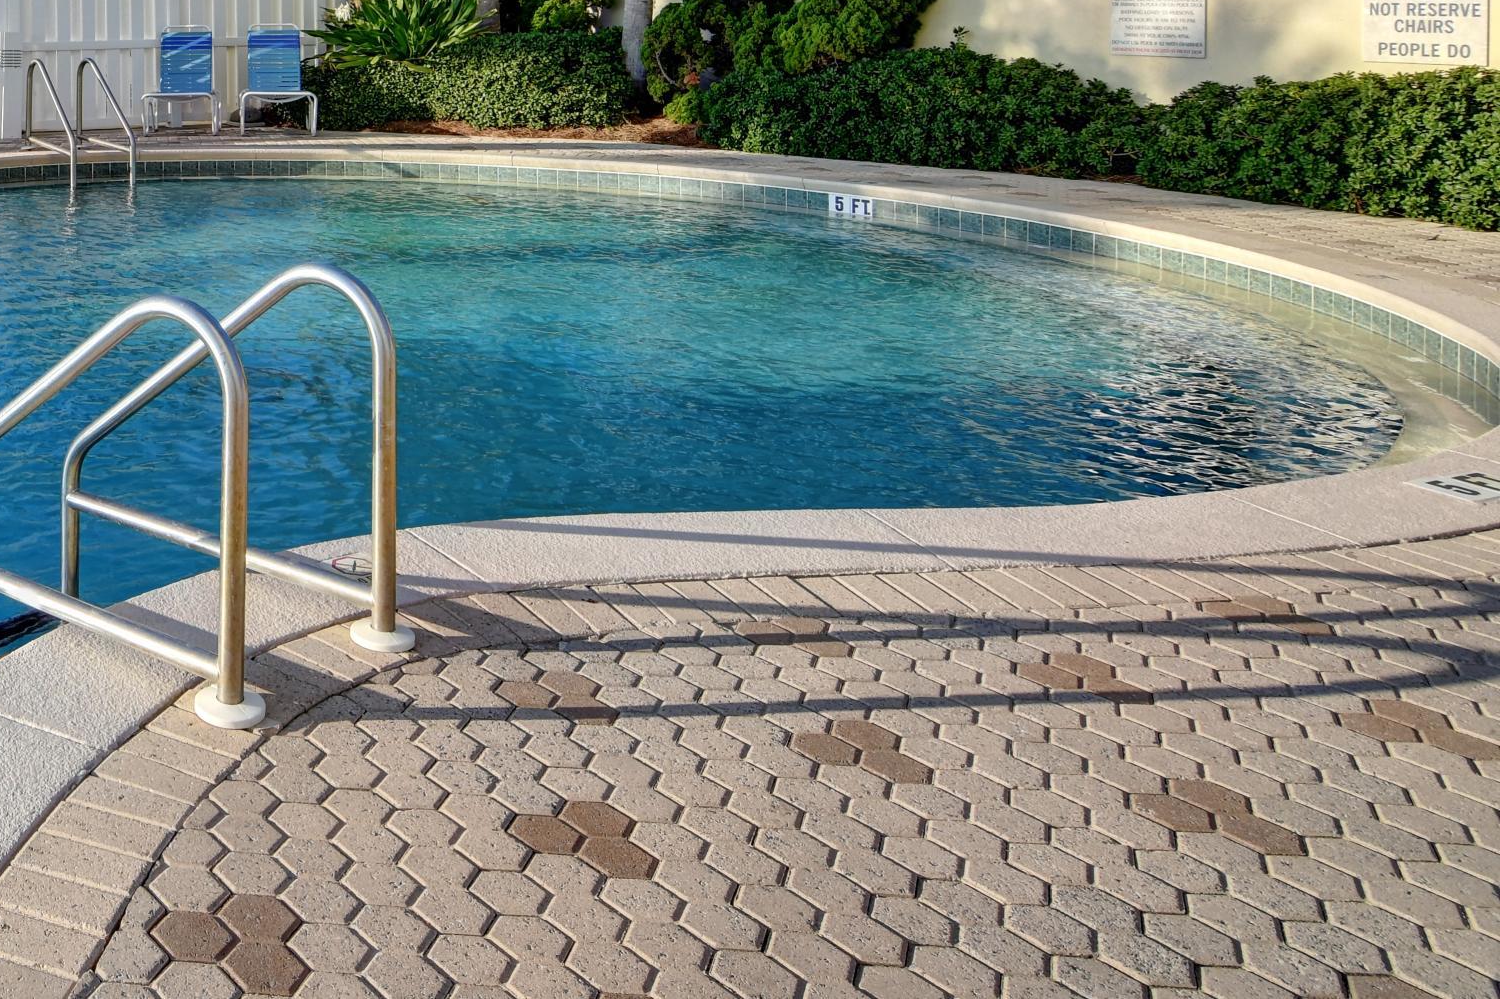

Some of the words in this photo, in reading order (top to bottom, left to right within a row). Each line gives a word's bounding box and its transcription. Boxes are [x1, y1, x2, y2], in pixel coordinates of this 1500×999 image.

[1369, 2, 1400, 16] NOT
[1406, 3, 1481, 18] RESERVE
[1394, 19, 1454, 34] CHAIRS
[1378, 42, 1441, 58] PEOPLE
[1447, 44, 1471, 59] DO
[835, 195, 844, 211] 5
[851, 198, 871, 215] FT.
[1425, 480, 1482, 496] 5
